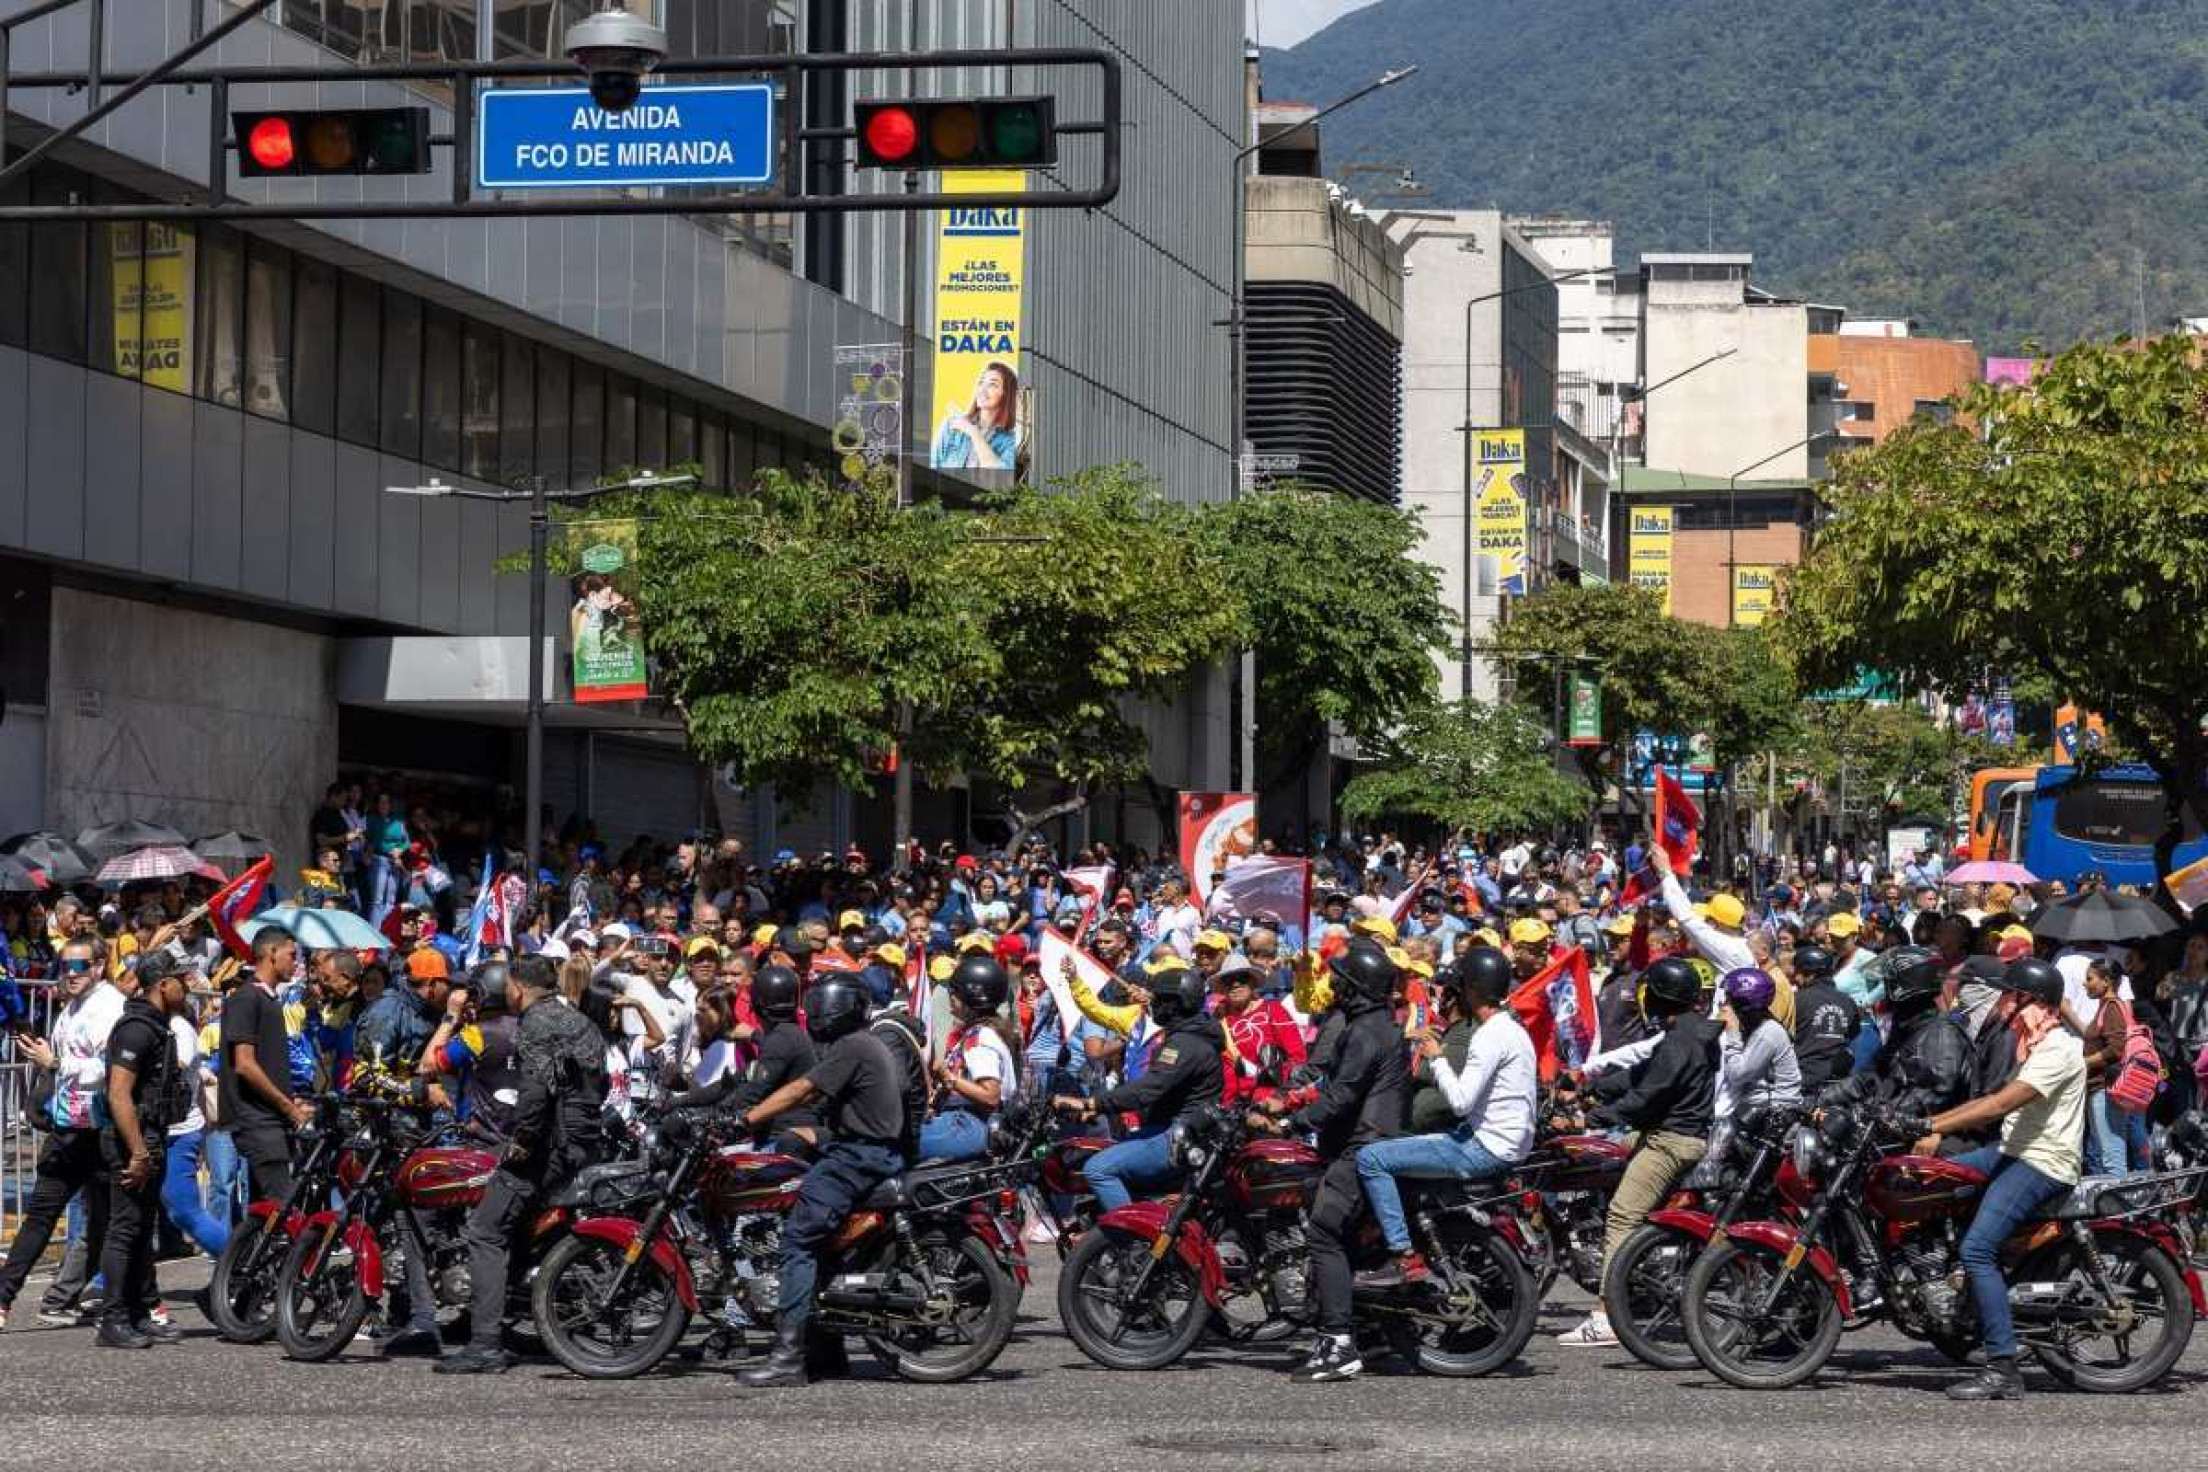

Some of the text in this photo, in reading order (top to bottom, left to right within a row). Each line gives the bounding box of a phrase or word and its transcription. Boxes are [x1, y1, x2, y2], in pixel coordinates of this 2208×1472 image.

[571, 105, 681, 130] AVENIDA
[516, 141, 734, 168] FCO DE MIRANDA
[964, 260, 997, 271] ¿LAS
[949, 271, 1010, 282] MEJORES
[941, 317, 1014, 331] ESTÁN EN
[941, 334, 1014, 353] DAKA
[1480, 438, 1520, 458] Daka
[1635, 514, 1669, 530] Daka
[1481, 537, 1523, 548] DAKA
[1740, 571, 1769, 587] Daka
